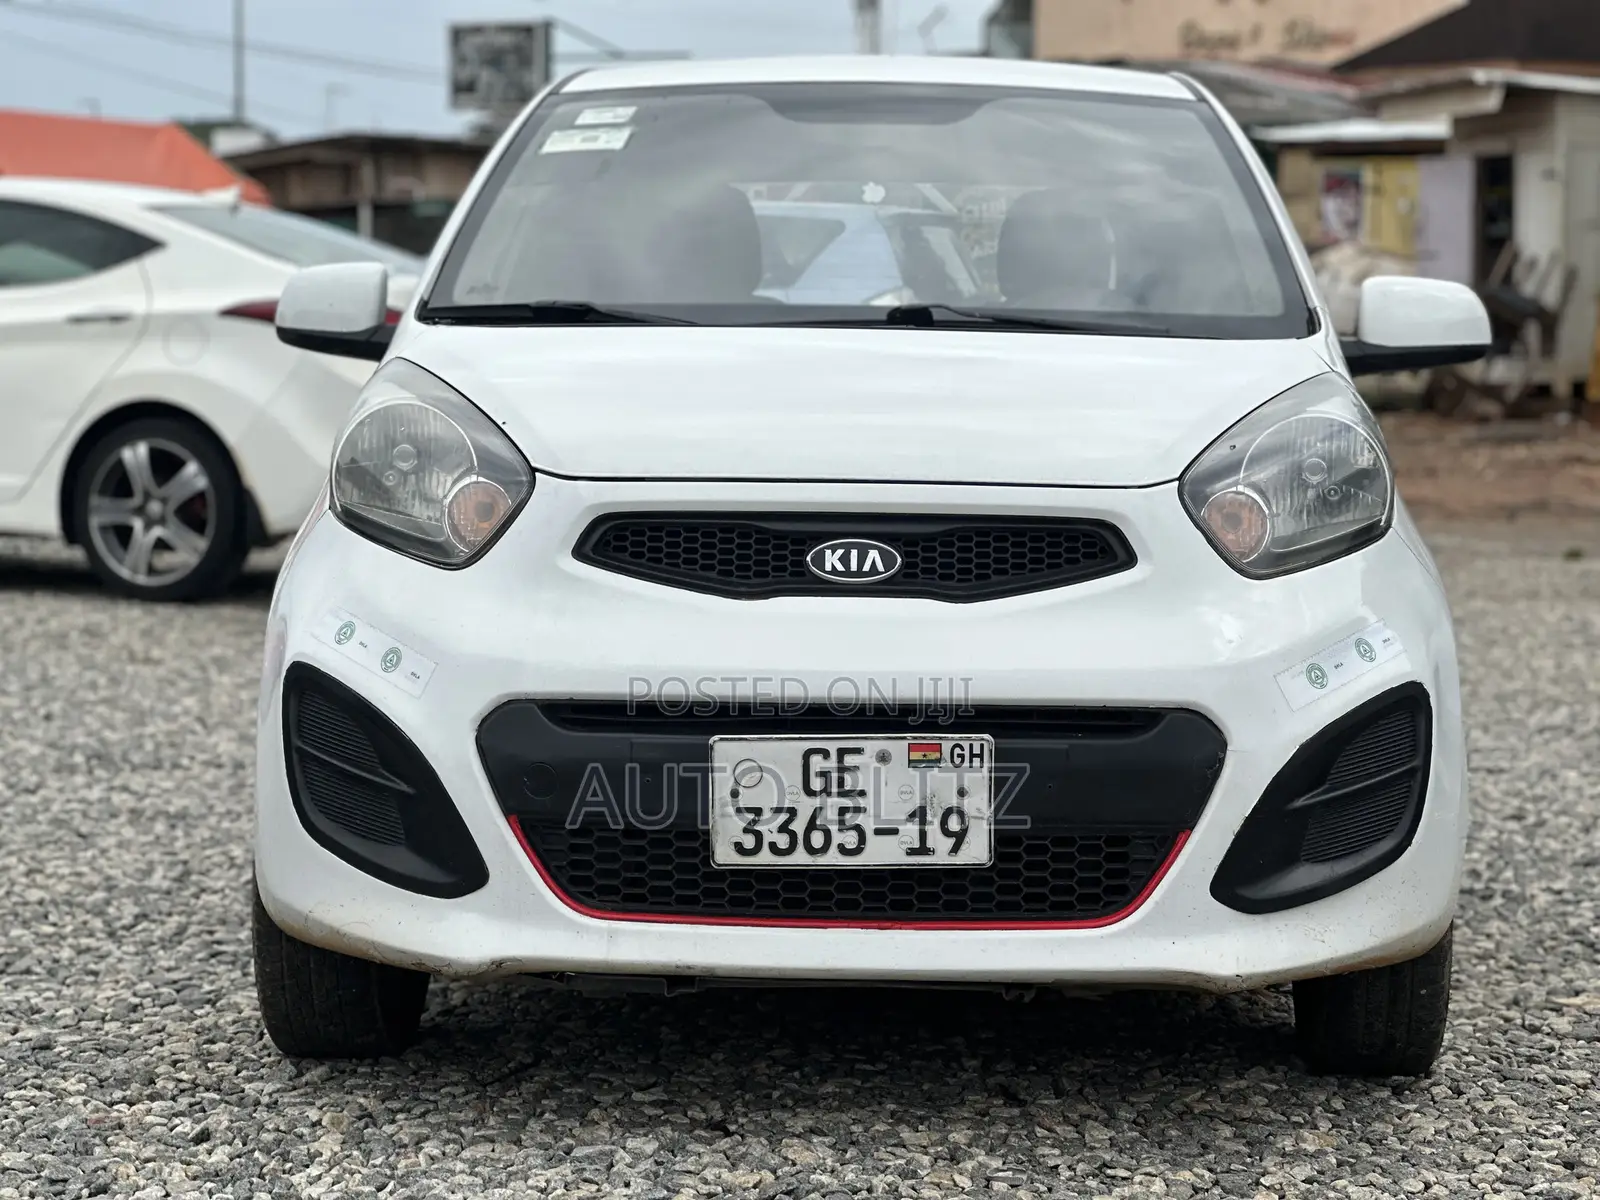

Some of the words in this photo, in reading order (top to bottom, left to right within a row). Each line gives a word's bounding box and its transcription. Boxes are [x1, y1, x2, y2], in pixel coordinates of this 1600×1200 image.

[824, 548, 885, 572] KIA
[802, 747, 867, 799] GE
[949, 743, 984, 769] GH
[734, 805, 970, 857] 3365-19
